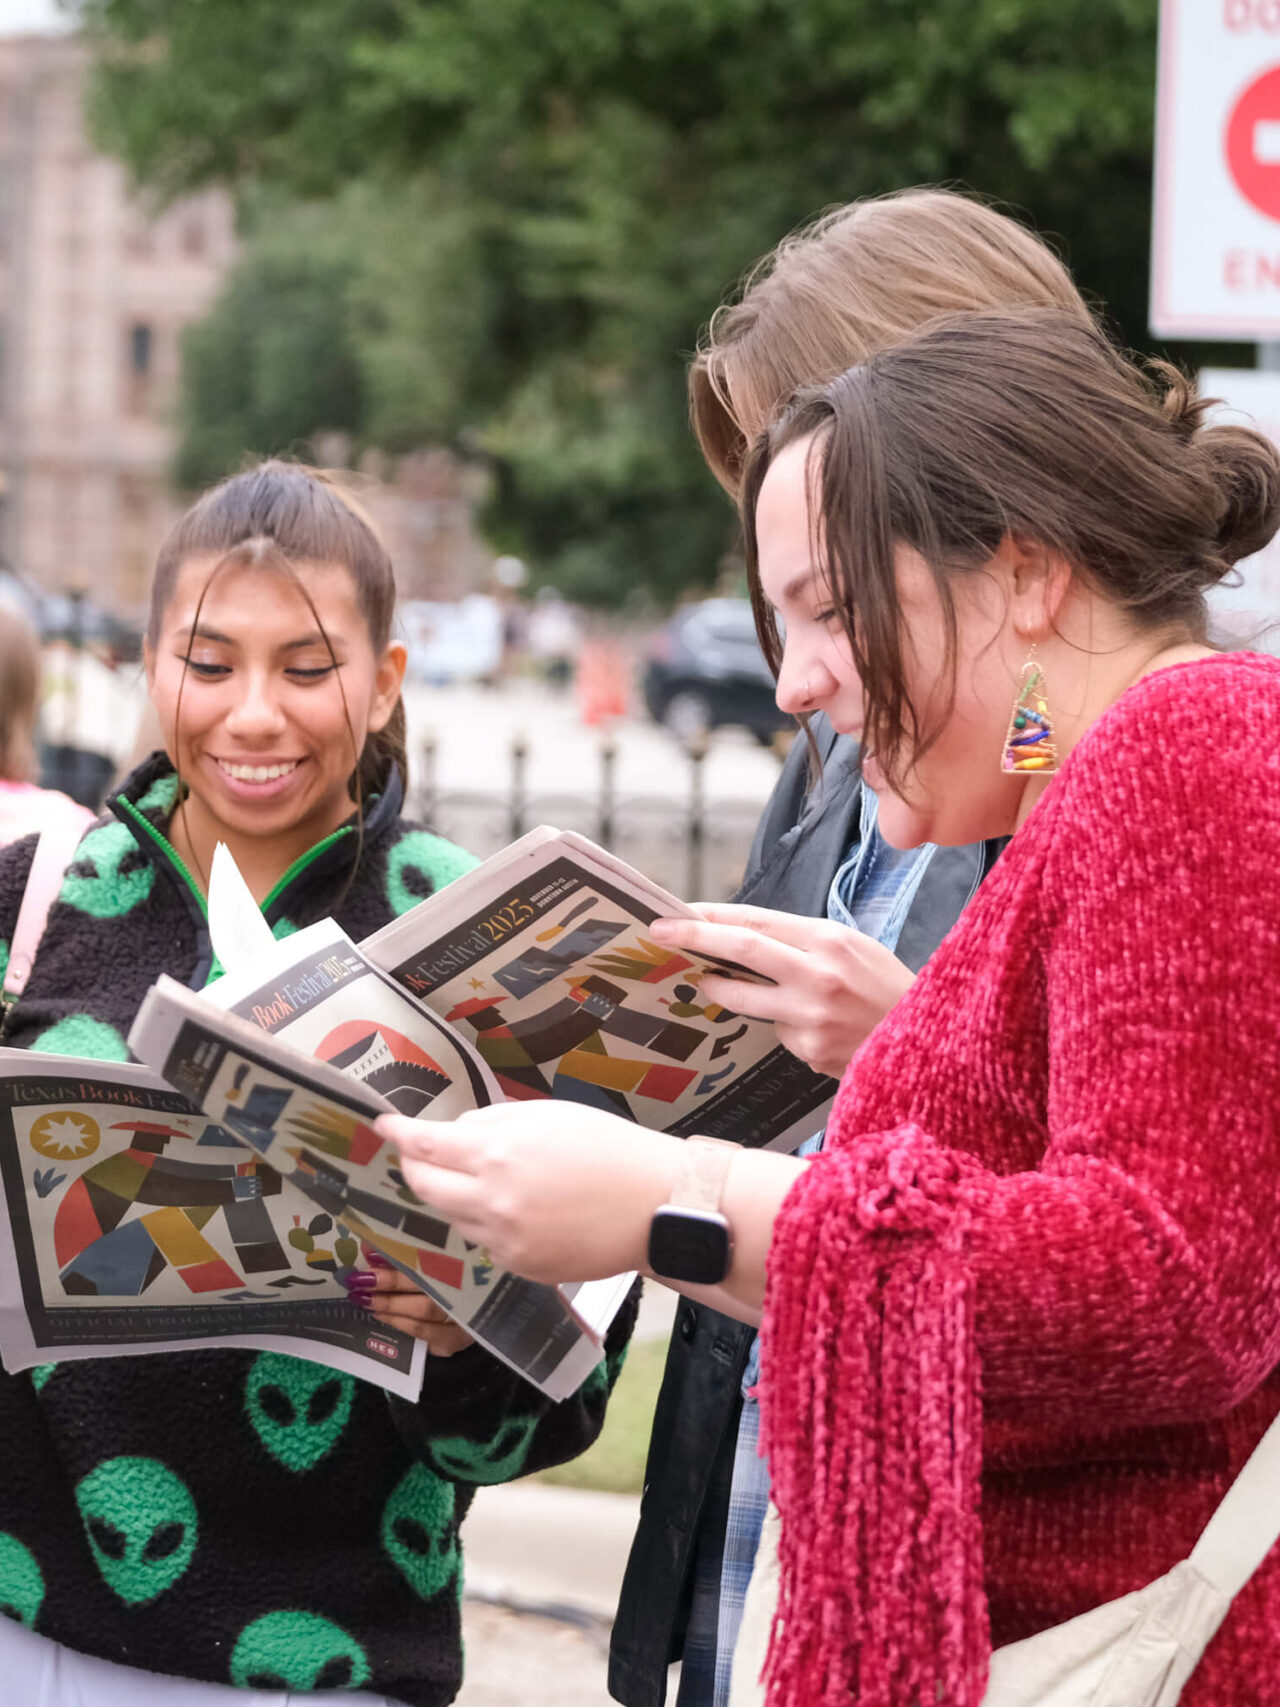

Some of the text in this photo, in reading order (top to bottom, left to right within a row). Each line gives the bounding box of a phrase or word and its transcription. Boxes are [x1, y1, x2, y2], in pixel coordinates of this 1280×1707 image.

[416, 929, 493, 982] Festival
[252, 991, 295, 1031] Book
[282, 965, 334, 1010] Festival
[5, 1083, 77, 1103] Texas
[79, 1083, 144, 1106] Book
